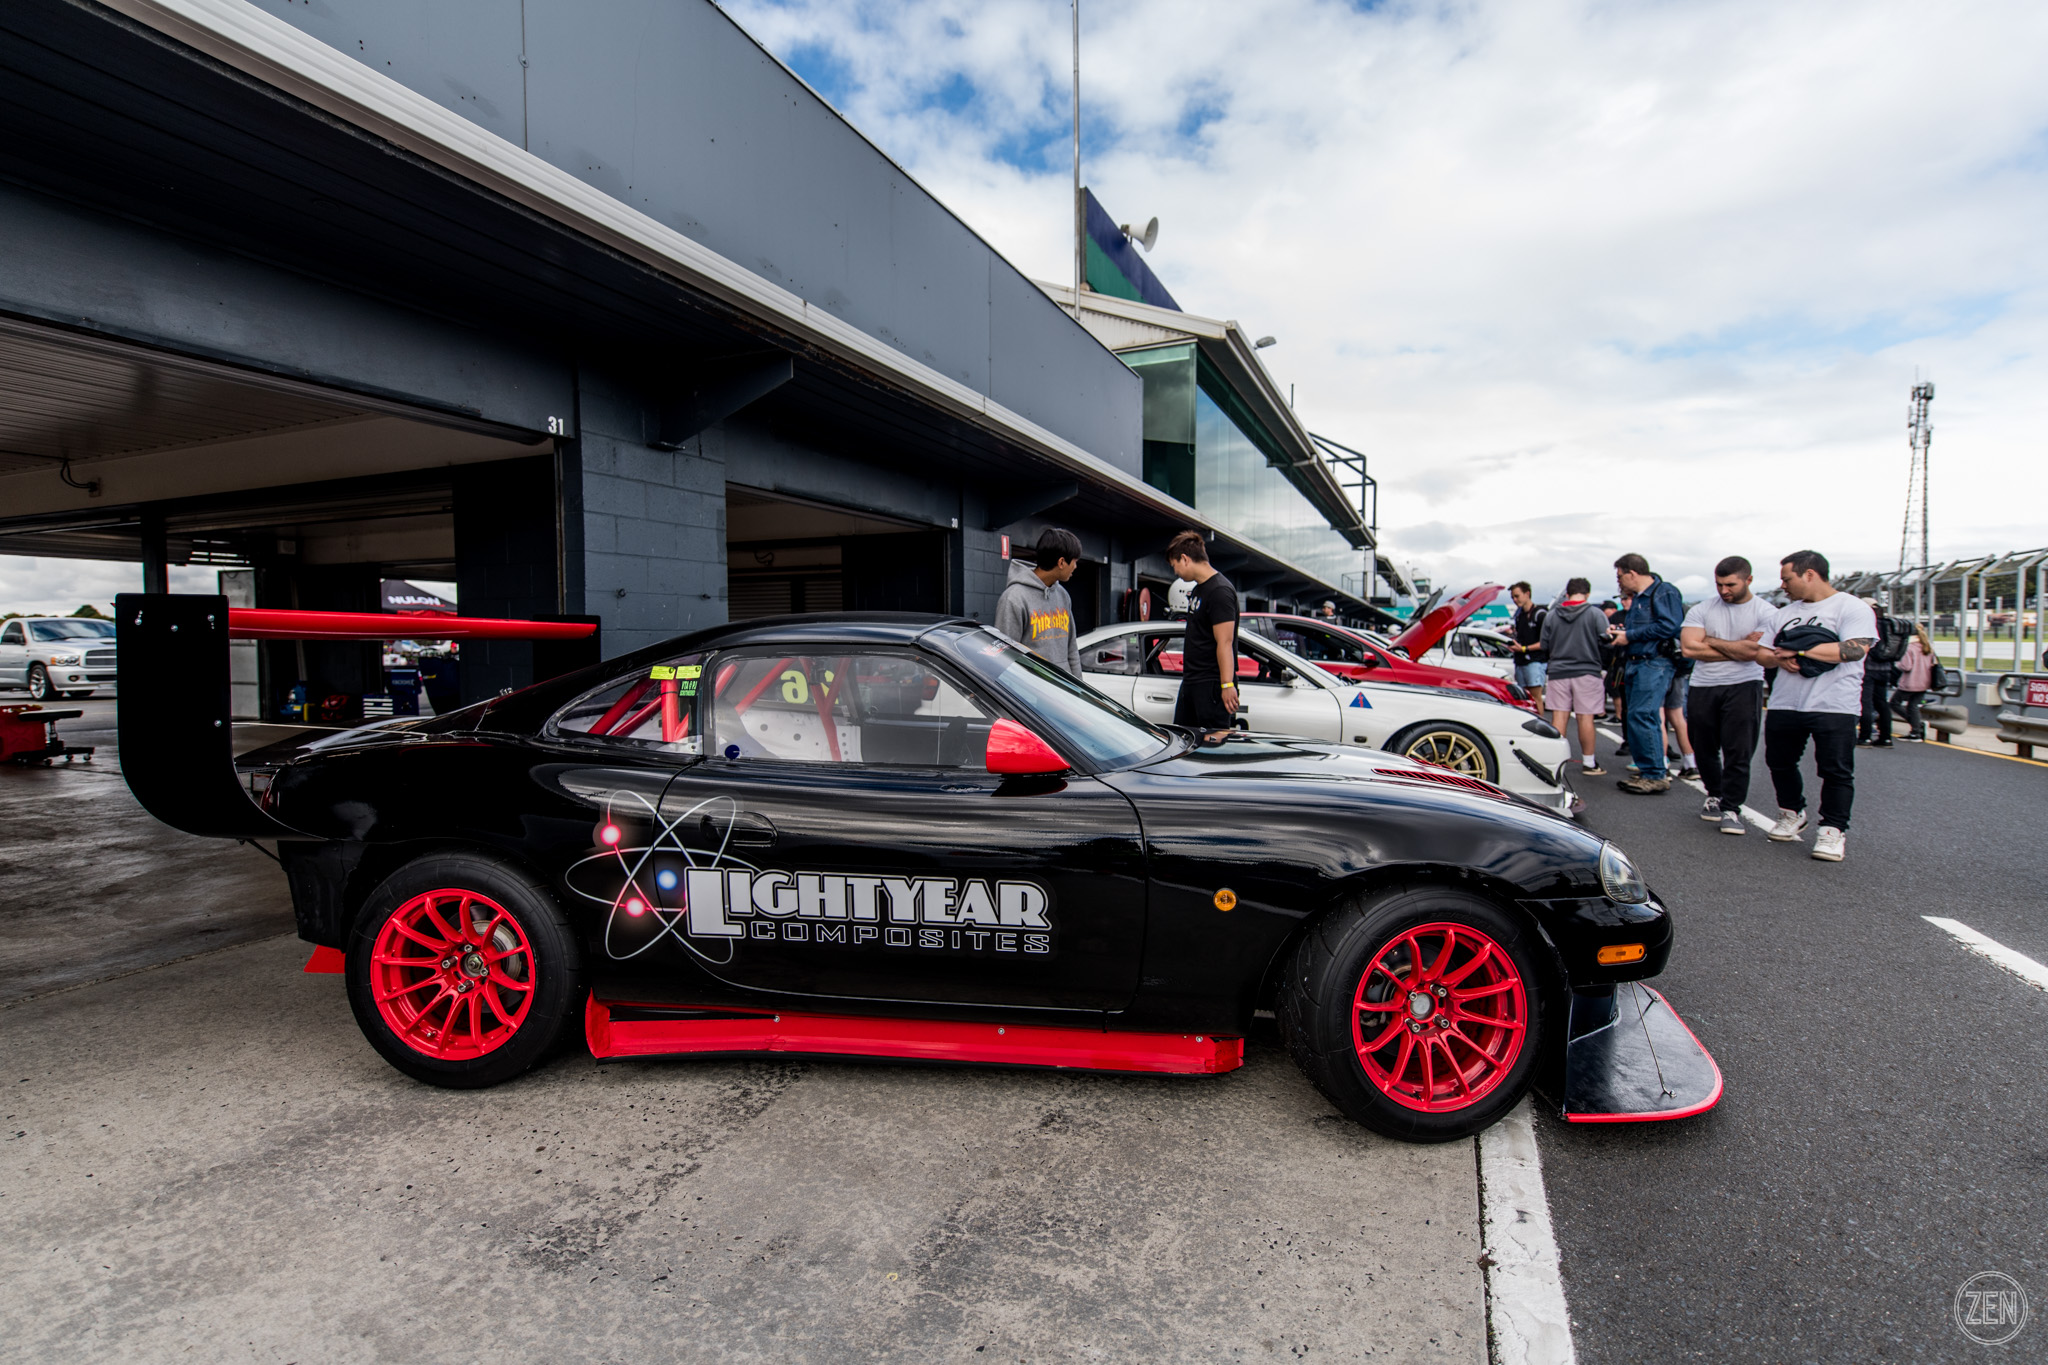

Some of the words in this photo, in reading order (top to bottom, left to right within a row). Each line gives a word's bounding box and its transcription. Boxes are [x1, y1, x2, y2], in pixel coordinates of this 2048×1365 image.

[548, 416, 564, 435] 31
[387, 595, 441, 606] NULON
[2032, 693, 2044, 703] NO
[684, 866, 1052, 939] LIGHTYEAR
[751, 921, 1050, 953] COMPOSITES
